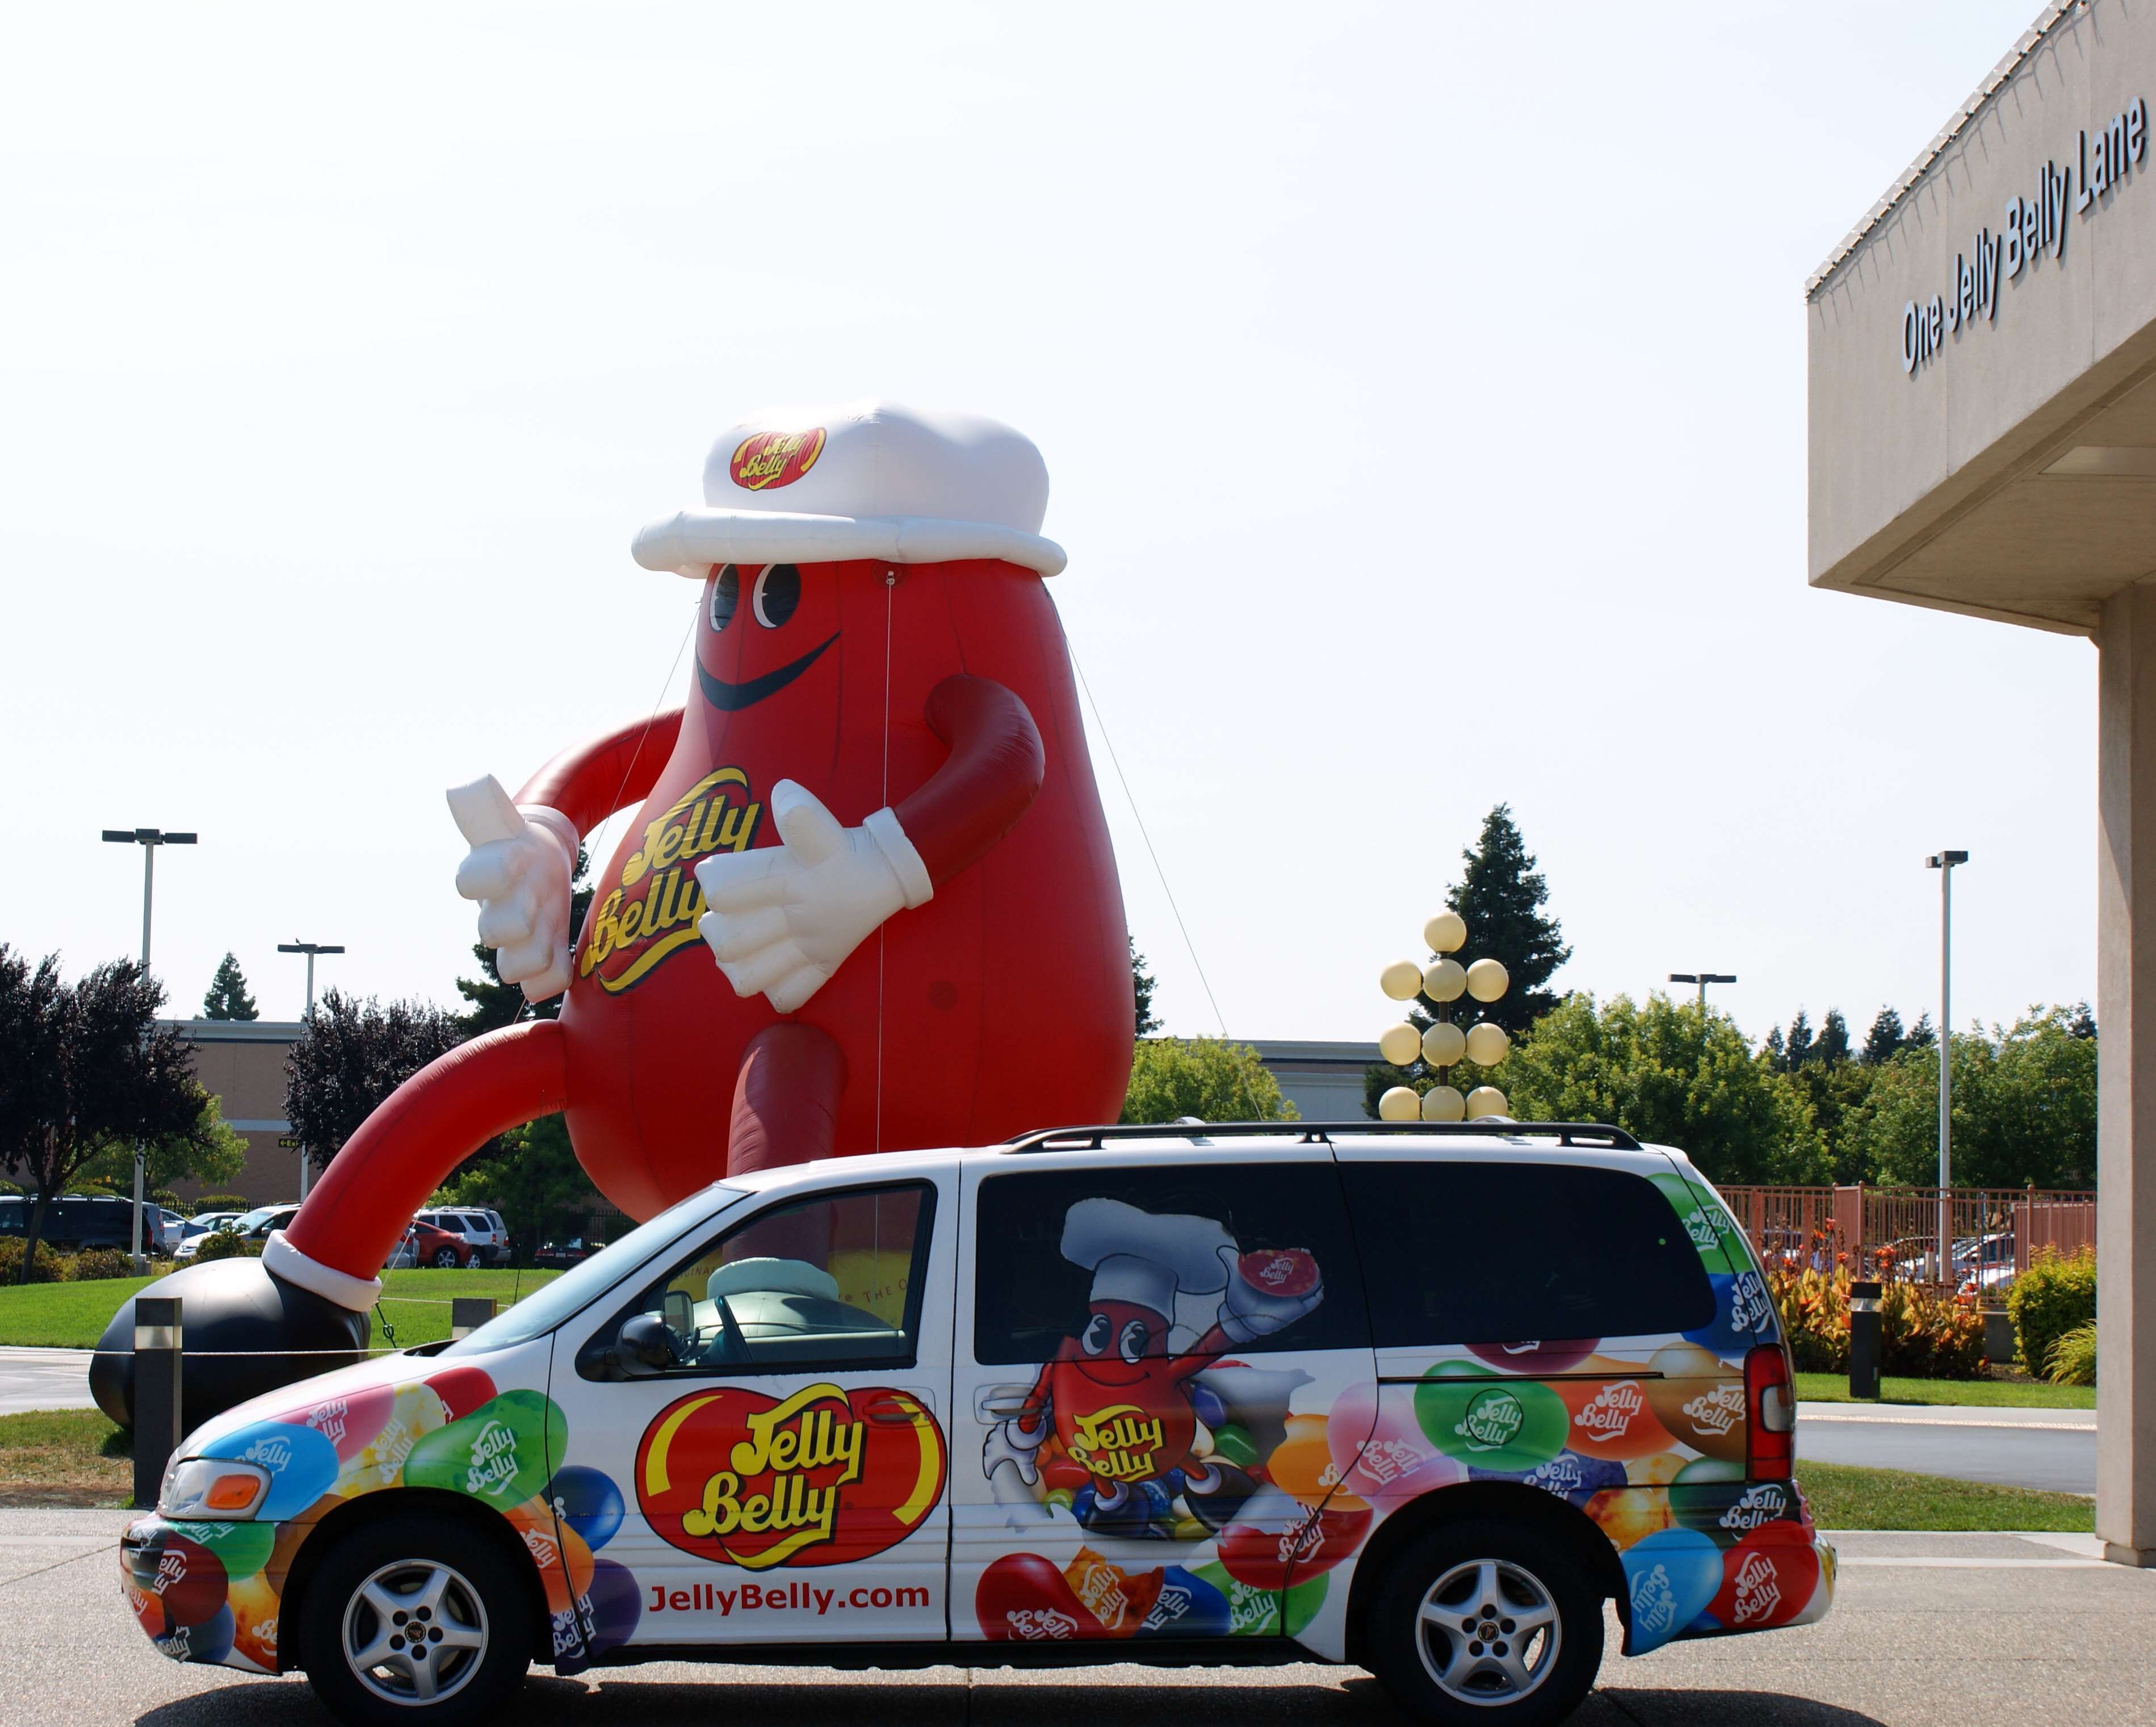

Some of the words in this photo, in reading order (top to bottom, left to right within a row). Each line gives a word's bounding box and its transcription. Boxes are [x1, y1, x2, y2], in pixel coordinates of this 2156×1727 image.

[1902, 294, 1942, 374] One
[1945, 228, 2001, 333] Jelly
[2006, 160, 2070, 279] Belly
[2075, 95, 2146, 215] Lane
[739, 455, 787, 491] Belly
[621, 767, 762, 886] Jelly
[581, 866, 708, 992] Belly
[1259, 1267, 1287, 1285] Belly
[1270, 1257, 1294, 1275] Jelly
[862, 1285, 892, 1303] THE
[306, 1399, 349, 1428] Jelly
[1477, 1396, 1523, 1431] Jelly
[1595, 1380, 1643, 1416] Jelly
[1682, 1396, 1734, 1435] Belly
[730, 1383, 865, 1486] Jelly
[1072, 1404, 1164, 1452] Jelly
[1454, 1414, 1508, 1452] Belly
[1574, 1403, 1630, 1442] Belly
[245, 1435, 292, 1472] Jelly
[471, 1420, 517, 1466] Jelly
[466, 1453, 519, 1495] Belly
[1356, 1440, 1399, 1486] Belly
[1536, 1454, 1582, 1489] Jelly
[1739, 1483, 1786, 1518] Jelly
[682, 1471, 838, 1570] Belly
[1718, 1505, 1775, 1542] Bell
[1080, 1563, 1120, 1608] Jelly
[1630, 1563, 1670, 1613] Belly
[1734, 1551, 1778, 1598] Jelly
[648, 1582, 930, 1616] JellyBelly.com
[1230, 1589, 1278, 1636] Belly
[1638, 1590, 1678, 1633] Jelly
[1733, 1582, 1781, 1623] Belly
[1006, 1609, 1047, 1640] Bell
